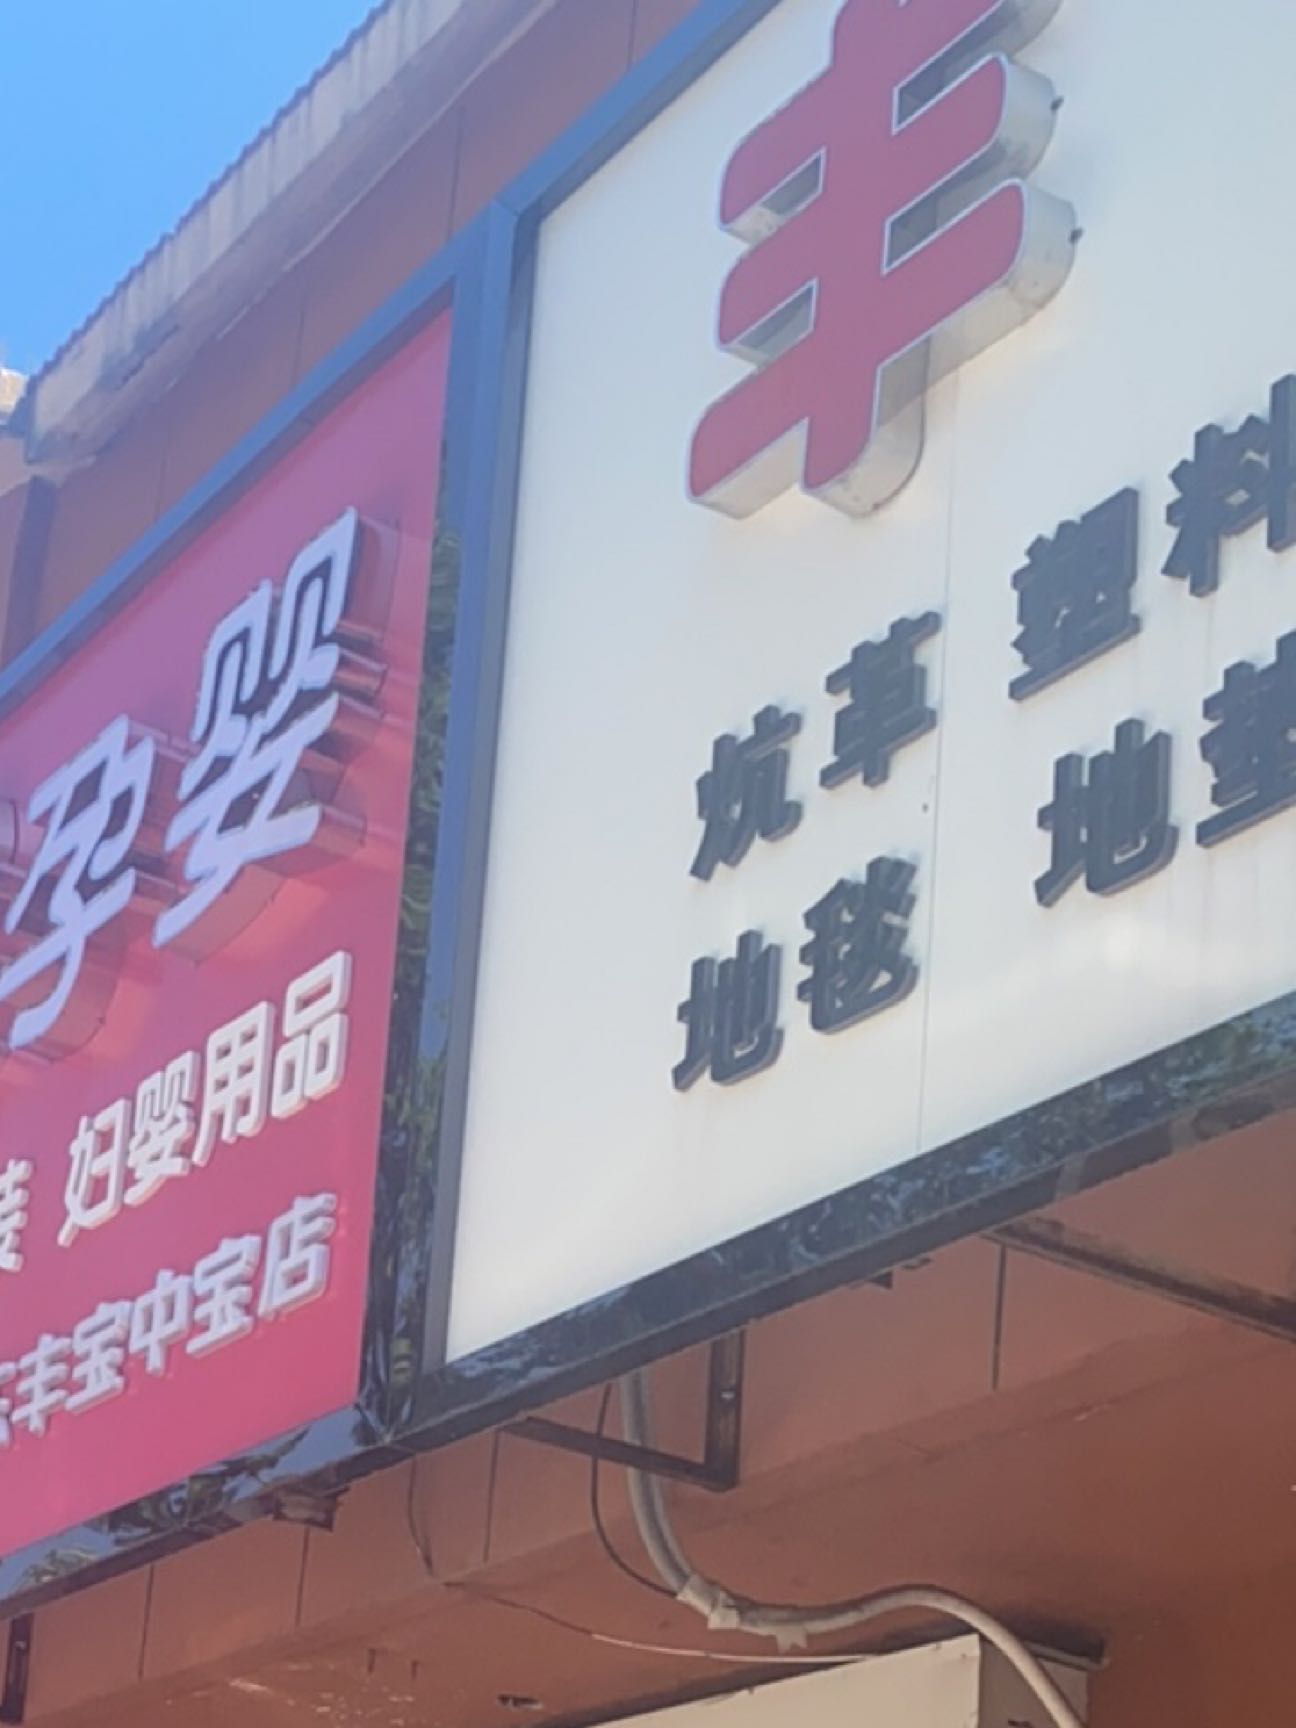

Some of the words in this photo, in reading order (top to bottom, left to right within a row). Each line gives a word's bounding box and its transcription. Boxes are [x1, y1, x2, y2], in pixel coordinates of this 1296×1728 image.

[690, 612, 941, 880] 炕革
[1008, 375, 1296, 701] 塑料
[672, 855, 919, 1090] 地毯
[1034, 630, 1296, 906] 地垫
[57, 951, 352, 1245] 妇婴用品
